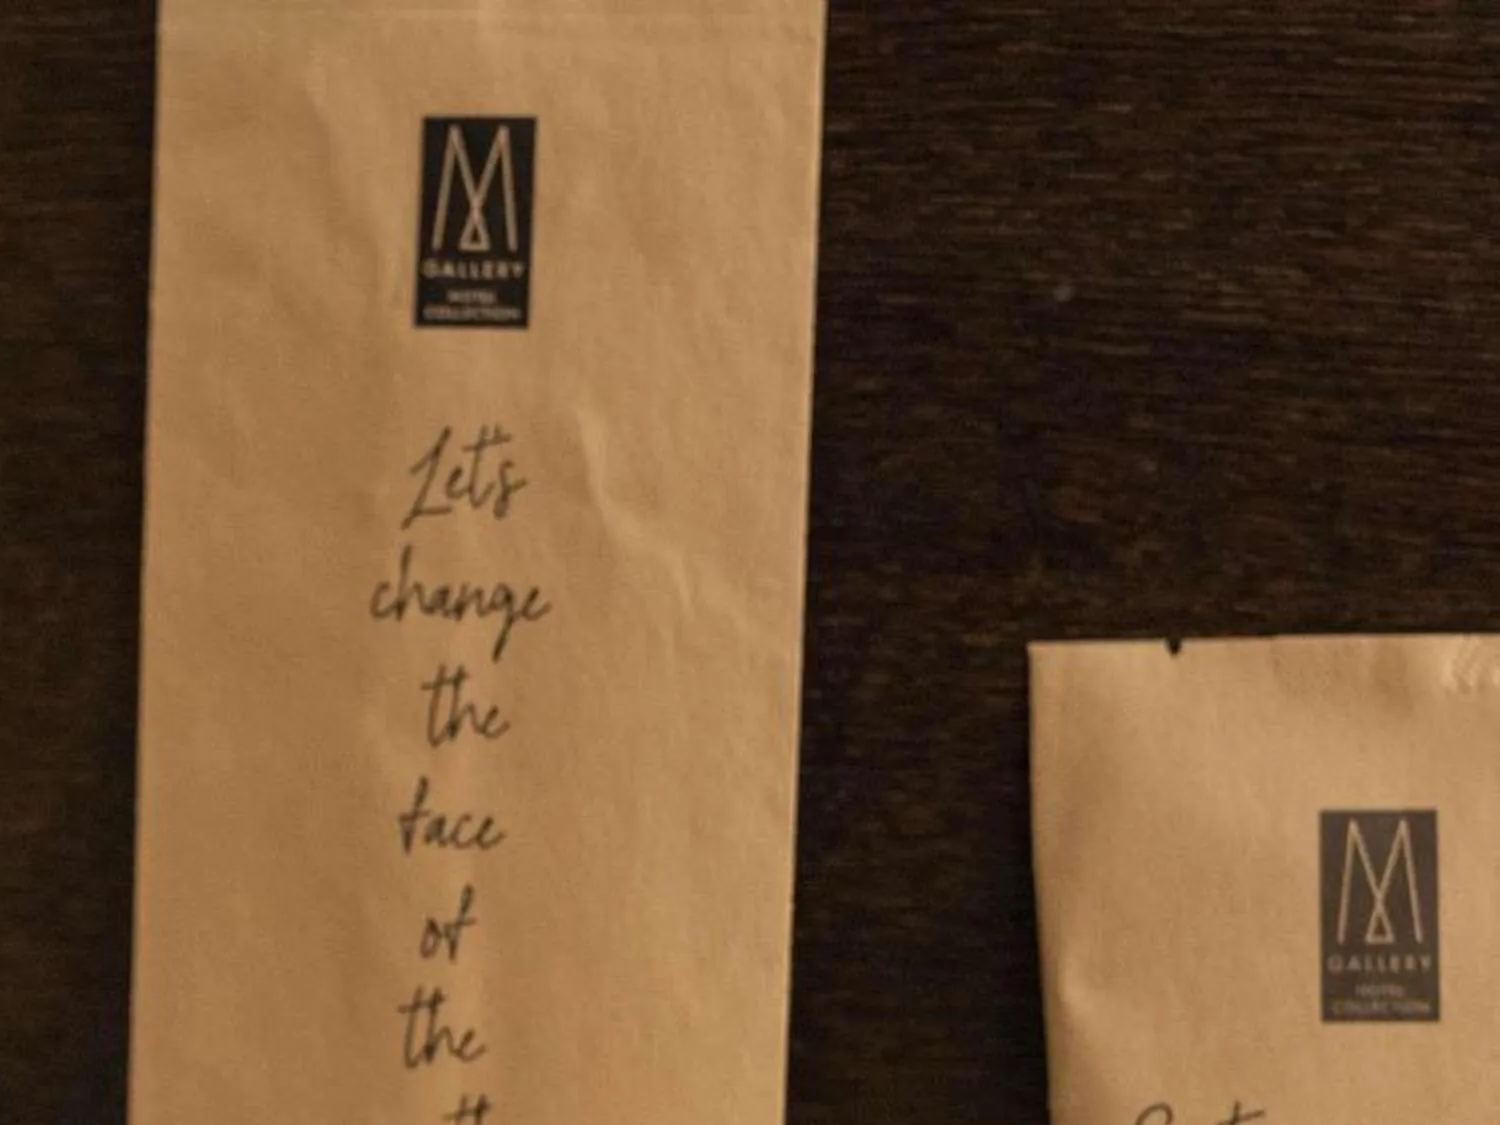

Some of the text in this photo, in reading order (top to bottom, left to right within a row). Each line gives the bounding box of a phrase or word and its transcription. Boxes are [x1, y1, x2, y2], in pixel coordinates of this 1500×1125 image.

[369, 544, 552, 664] change
[421, 664, 511, 747] the
[398, 775, 506, 855] face
[419, 883, 477, 961] of
[397, 985, 488, 1070] the
